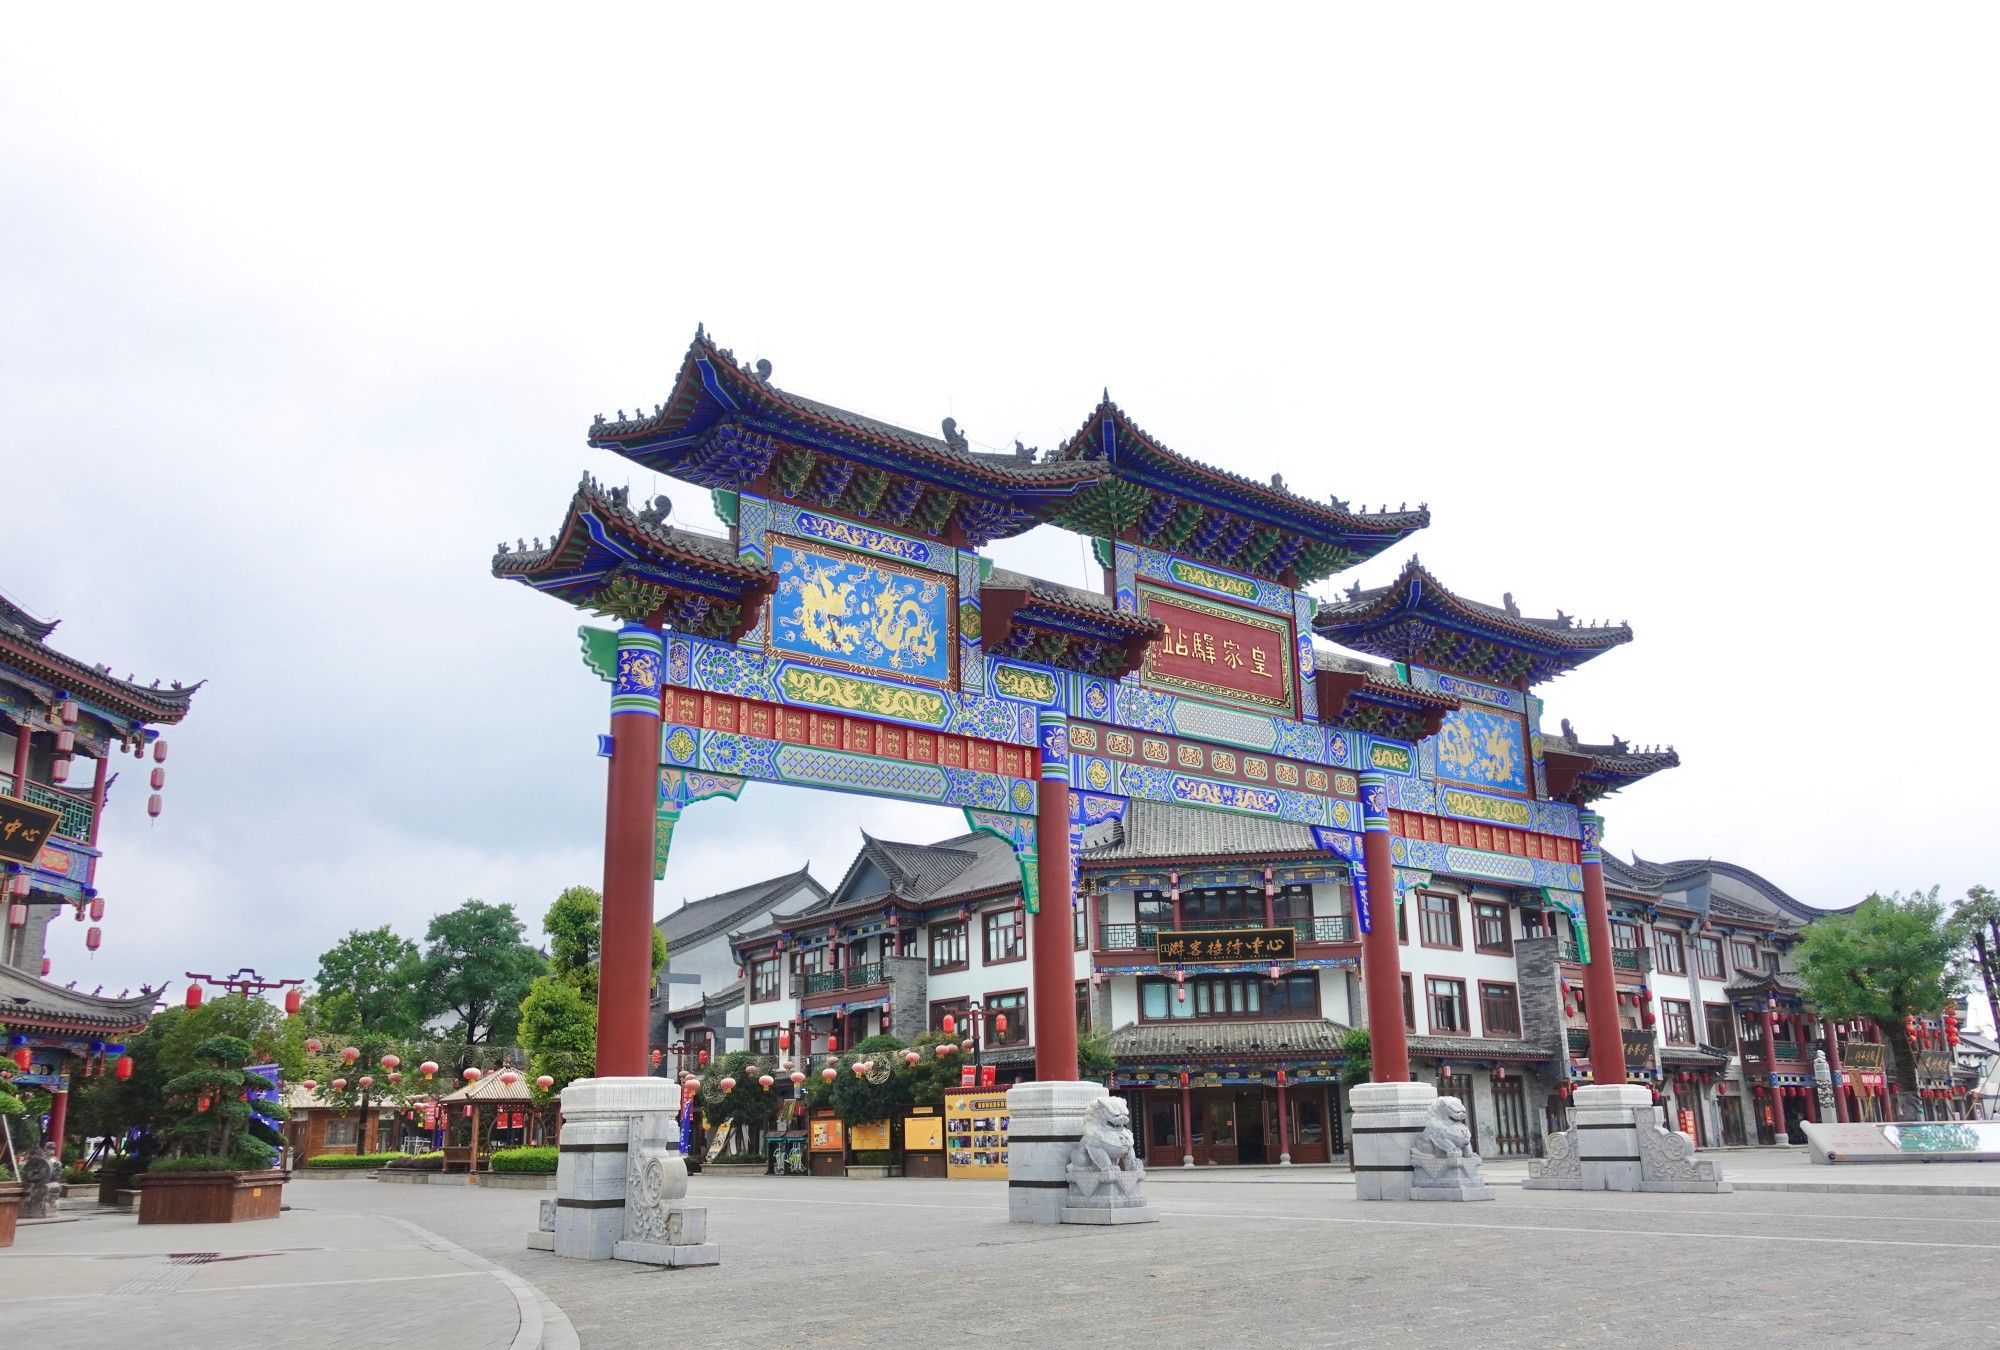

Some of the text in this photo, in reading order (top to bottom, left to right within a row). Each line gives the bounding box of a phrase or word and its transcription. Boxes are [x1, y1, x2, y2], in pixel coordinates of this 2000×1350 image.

[1162, 623, 1273, 678] 皇家驛站
[0, 815, 40, 842] 中心
